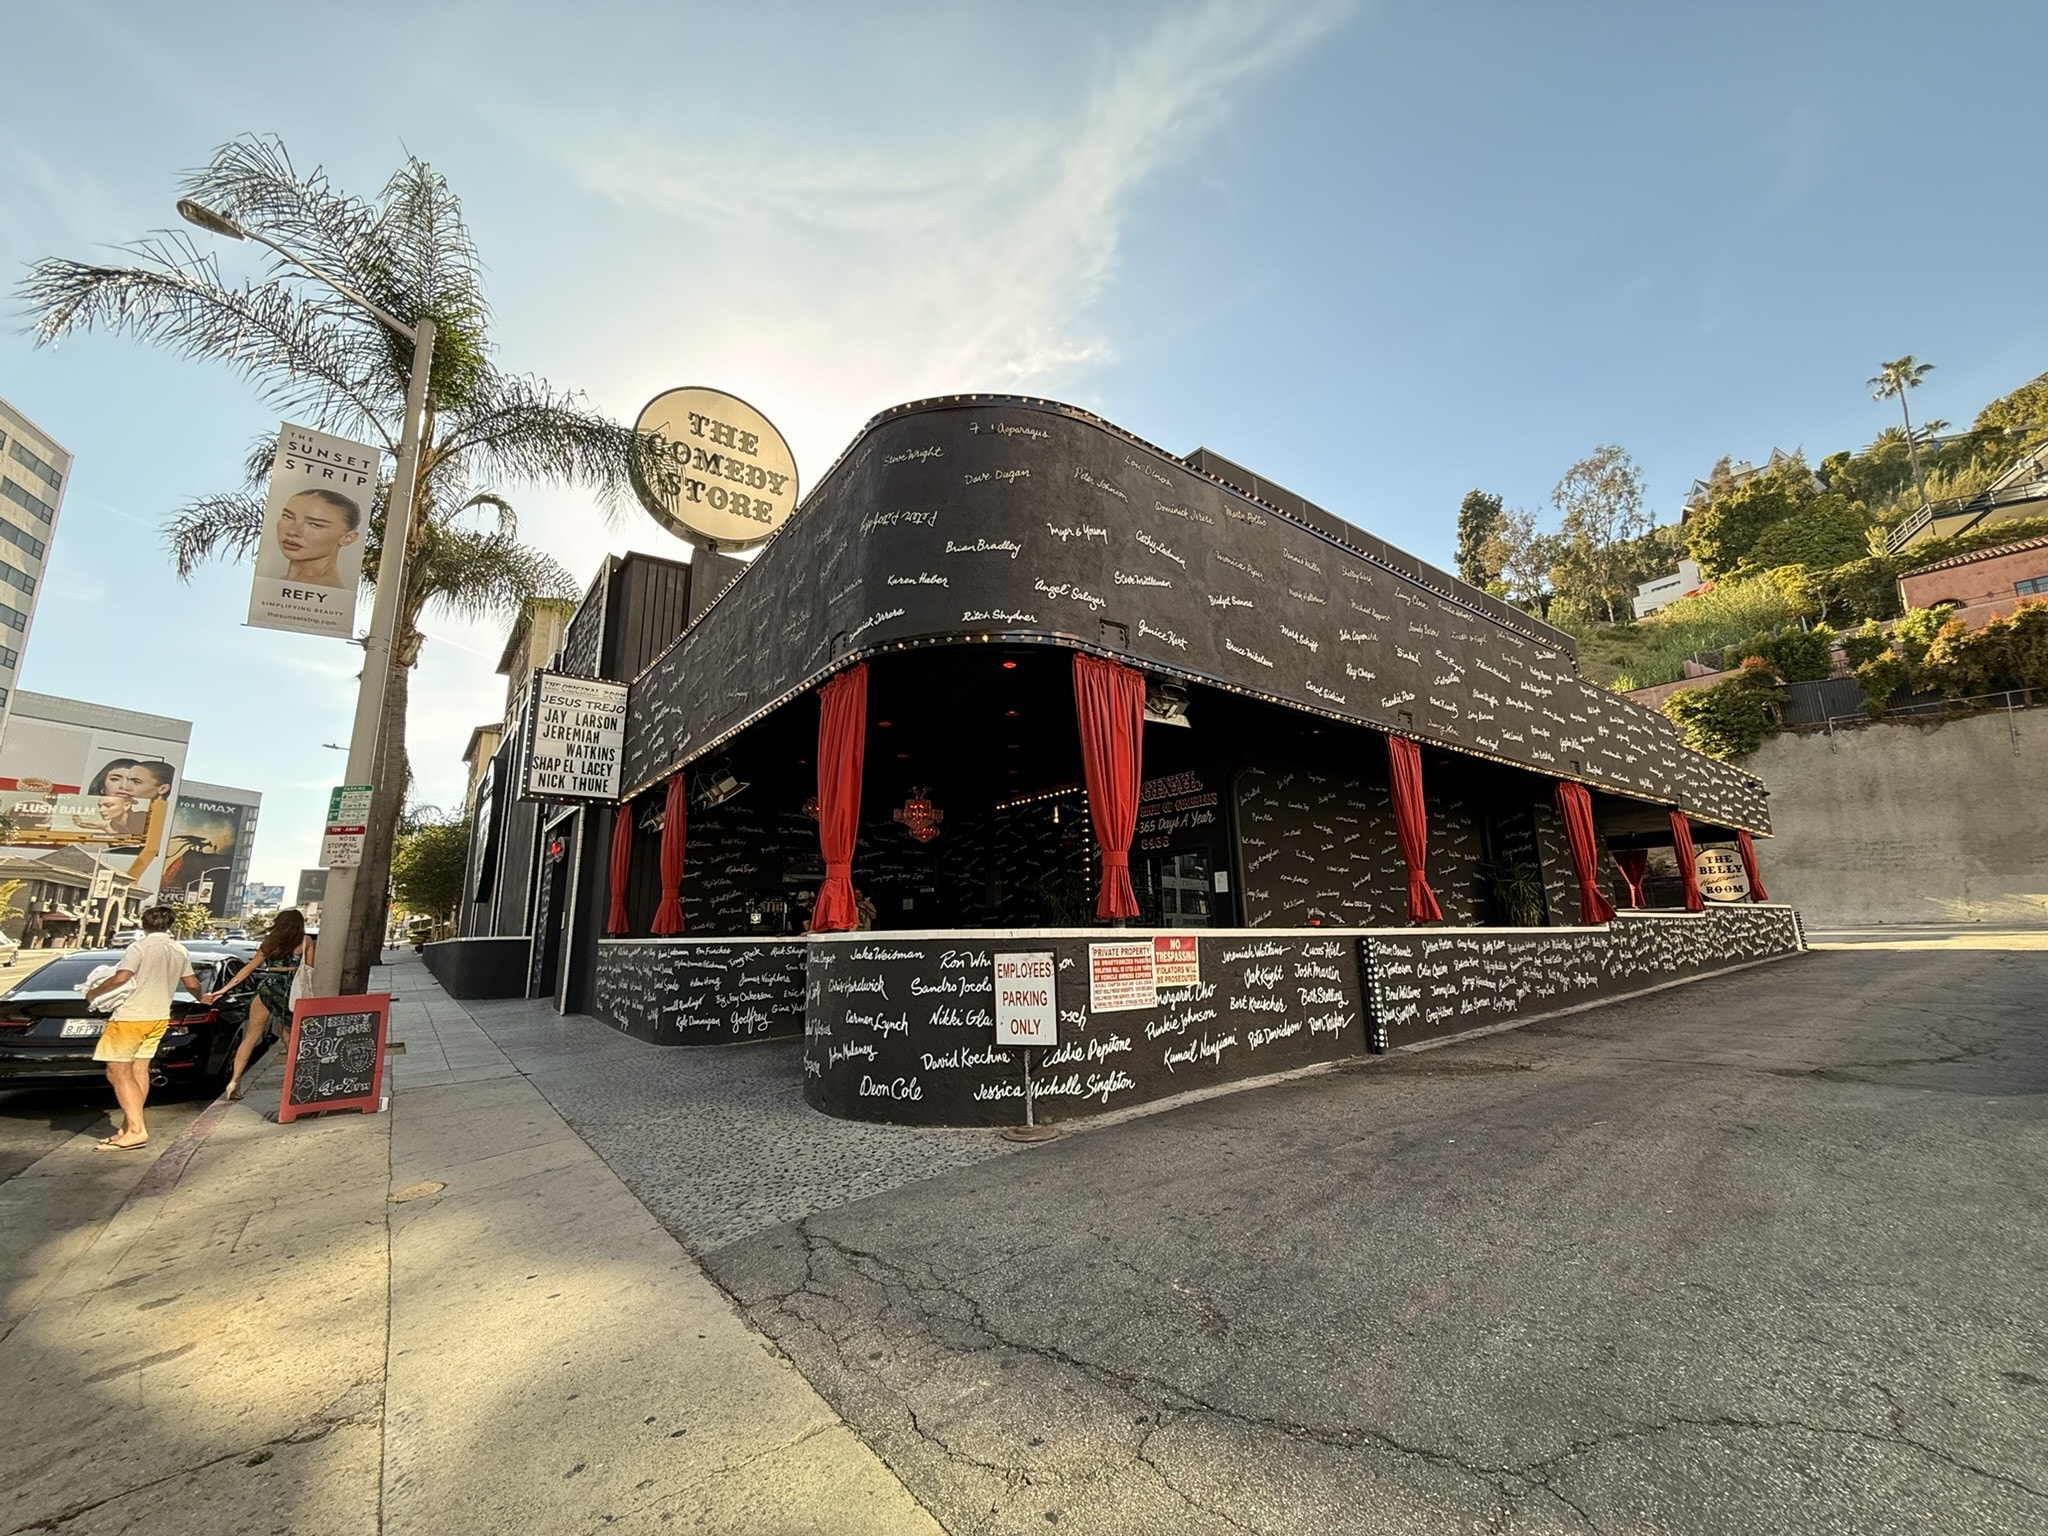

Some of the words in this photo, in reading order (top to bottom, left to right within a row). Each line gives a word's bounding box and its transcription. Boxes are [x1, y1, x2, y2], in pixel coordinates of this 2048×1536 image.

[291, 432, 313, 442] THE
[688, 411, 759, 458] THE
[288, 441, 371, 469] SUNSET
[285, 460, 368, 486] STRIP
[965, 473, 990, 485] Dave
[1097, 479, 1129, 503] Johnson
[1083, 524, 1108, 545] Young
[1136, 530, 1156, 554] Cathy
[945, 541, 976, 553] Brian
[977, 538, 1022, 559] Bradley
[888, 574, 917, 586] Karen
[919, 572, 949, 588] Haber
[282, 588, 329, 603] REFY
[262, 601, 312, 613] SIMPLIFYING
[314, 608, 344, 617] BEAUTY
[267, 611, 338, 627] thesunsetstrip.com
[992, 609, 1038, 623] Shydner
[541, 694, 582, 708] JESUS
[586, 701, 626, 714] TREJO
[544, 708, 568, 724] JAY
[576, 713, 618, 731] LARSON
[543, 725, 600, 745] JEREMIAH
[567, 743, 616, 762] WATKINS
[581, 761, 613, 783] LACEY
[538, 773, 566, 789] NICK
[572, 777, 609, 793] THUNE
[14, 803, 58, 814] FLUSH
[60, 805, 97, 816] BALM
[199, 802, 237, 814] IMAX
[1139, 820, 1156, 833] 365
[1158, 816, 1179, 835] Days
[1180, 813, 1189, 827] A
[1191, 810, 1216, 828] Year
[1705, 855, 1733, 864] THE
[1698, 865, 1742, 875] BELLY
[1706, 885, 1744, 894] ROOM
[851, 946, 873, 961] Jake
[873, 946, 925, 961] Weisman
[1093, 948, 1120, 957] PRIVATE
[1121, 947, 1150, 956] PROPERTY
[1170, 939, 1180, 950] NO
[1222, 945, 1254, 964] Jeremiah
[1156, 951, 1196, 962] TRESPASSING
[998, 962, 1051, 979] EMPLOYEES
[1156, 966, 1185, 975] VIOLATORS
[1186, 965, 1197, 973] WILL
[1157, 976, 1163, 984] BE
[1164, 975, 1197, 983] PROSECUTED
[1259, 965, 1284, 990] Knight
[1294, 962, 1312, 978] Josh
[1311, 962, 1341, 982] Martin
[911, 976, 957, 996] Sandro
[1195, 981, 1217, 1001] Cho
[1003, 991, 1048, 1007] PARKING
[1297, 988, 1319, 1006] Beth
[730, 1006, 773, 1034] Godfrey
[846, 1010, 873, 1024] Carmen
[873, 1012, 909, 1039] Lynch
[929, 1005, 963, 1026] Nikki
[966, 1009, 994, 1027] Gla
[1144, 1015, 1180, 1041] Punkie
[1178, 1007, 1217, 1035] Johnson
[1011, 1019, 1041, 1035] ONLY
[1263, 1019, 1303, 1044] Davidson
[1308, 1017, 1325, 1036] Ron
[1088, 1033, 1132, 1065] Pepitone
[1164, 1039, 1198, 1073] Kumail
[920, 1049, 959, 1070] David
[860, 1075, 890, 1097] Deon
[891, 1077, 923, 1101] Cole
[973, 1081, 1026, 1101] Jessica
[1082, 1071, 1136, 1104] Singleton
